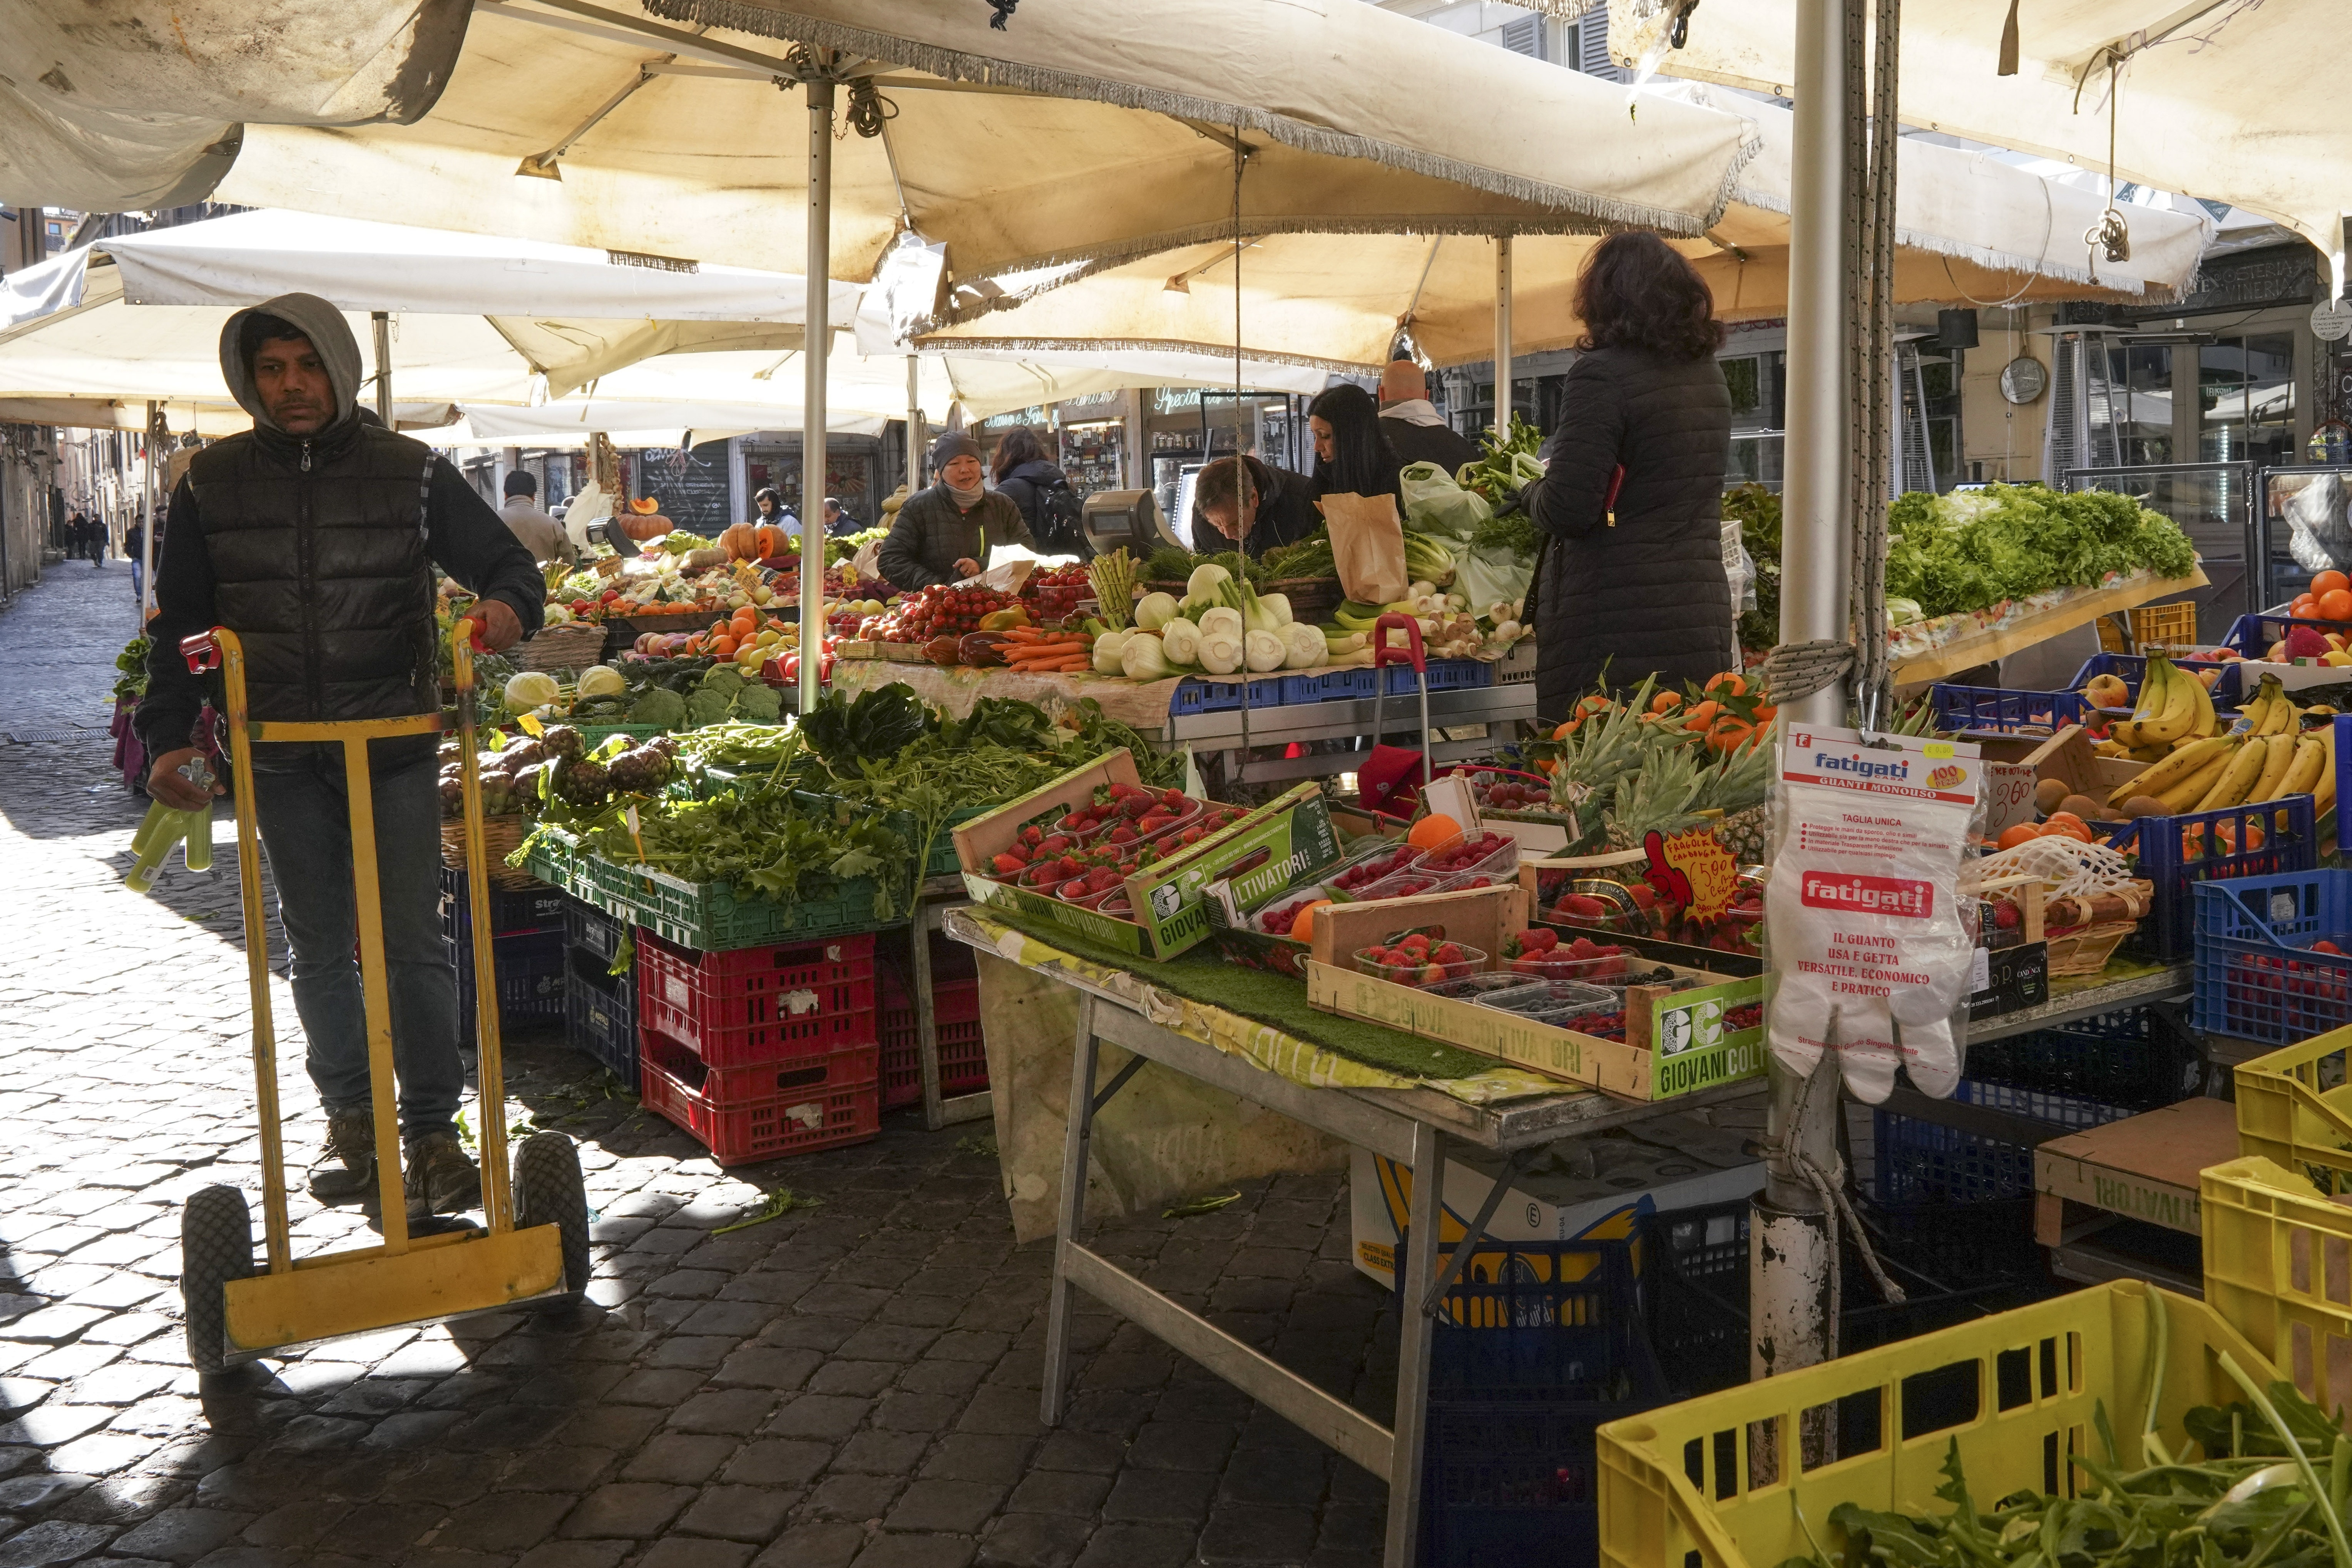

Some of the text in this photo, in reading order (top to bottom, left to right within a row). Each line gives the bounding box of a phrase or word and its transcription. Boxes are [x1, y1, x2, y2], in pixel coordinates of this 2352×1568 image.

[2223, 260, 2293, 283] OSTERIA
[2225, 279, 2294, 301] VINERIA
[1815, 753, 1909, 778] fatigati
[1932, 765, 1958, 782] 100
[1820, 776, 1937, 799] GUANTI MONOUSO
[1935, 776, 1960, 788] PEZZI
[1809, 823, 1833, 832] Protegge
[1843, 814, 1902, 827] TAGLIA UNICA
[1809, 830, 1838, 839] Utilizzabile
[1666, 839, 1710, 853] FRAGOLE
[1808, 845, 1837, 854] Utilizzabile
[1874, 851, 1896, 859] impiego
[1841, 841, 1873, 850] Trasparente
[1874, 843, 1903, 852] Polietilene
[1673, 849, 1717, 861] CANDONGA
[1807, 879, 1925, 908] fatigati
[535, 899, 562, 909] Stra
[1881, 905, 1922, 914] CASA
[1833, 932, 1895, 949] IL GUANTO
[1828, 948, 1899, 966] USA E GETTA
[1797, 960, 1930, 985] VERSATILE, ECONOMICO
[1832, 981, 1891, 997] E PRATICO
[1798, 1036, 1919, 1056] Strappare ogni Guanto Singolarmente
[1661, 1041, 1766, 1093] GIOVANICOLT
[1530, 1206, 1537, 1223] E
[1362, 1243, 1380, 1254] SELECTED
[1364, 1252, 1380, 1265] CLASS
